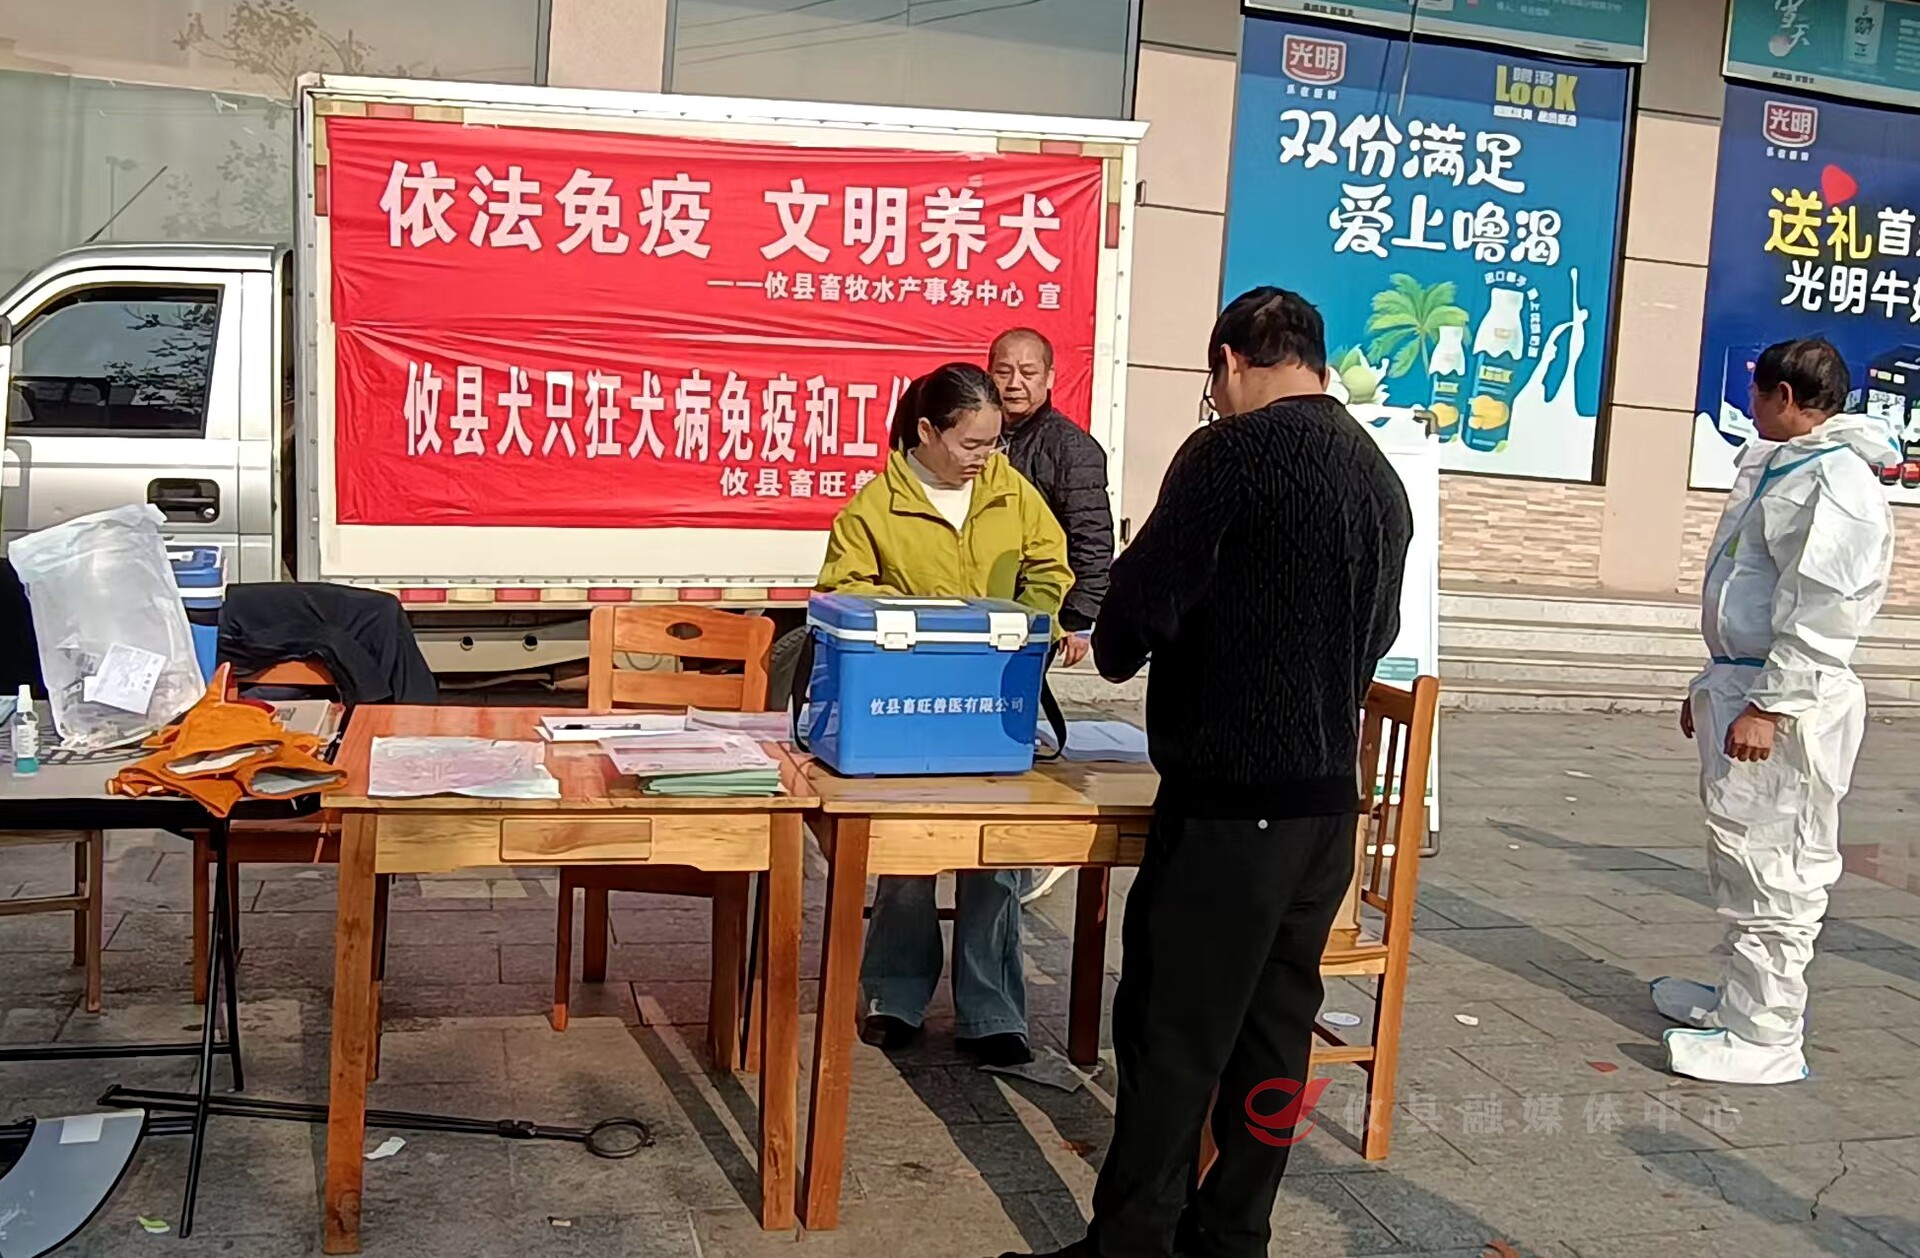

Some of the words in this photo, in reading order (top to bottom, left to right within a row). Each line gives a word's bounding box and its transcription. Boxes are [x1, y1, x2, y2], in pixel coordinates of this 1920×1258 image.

[1289, 42, 1340, 70] 光明
[1769, 108, 1812, 134] 光明
[1279, 109, 1526, 194] 双份满足
[379, 160, 712, 259] 依法免疫
[760, 178, 1062, 272] 文明养犬
[1329, 183, 1562, 266] 爱上噜渴
[1764, 187, 1920, 261] 送礼首
[1037, 282, 1061, 310] 宣
[870, 697, 1024, 715] 攸县畜旺兽医有限公司
